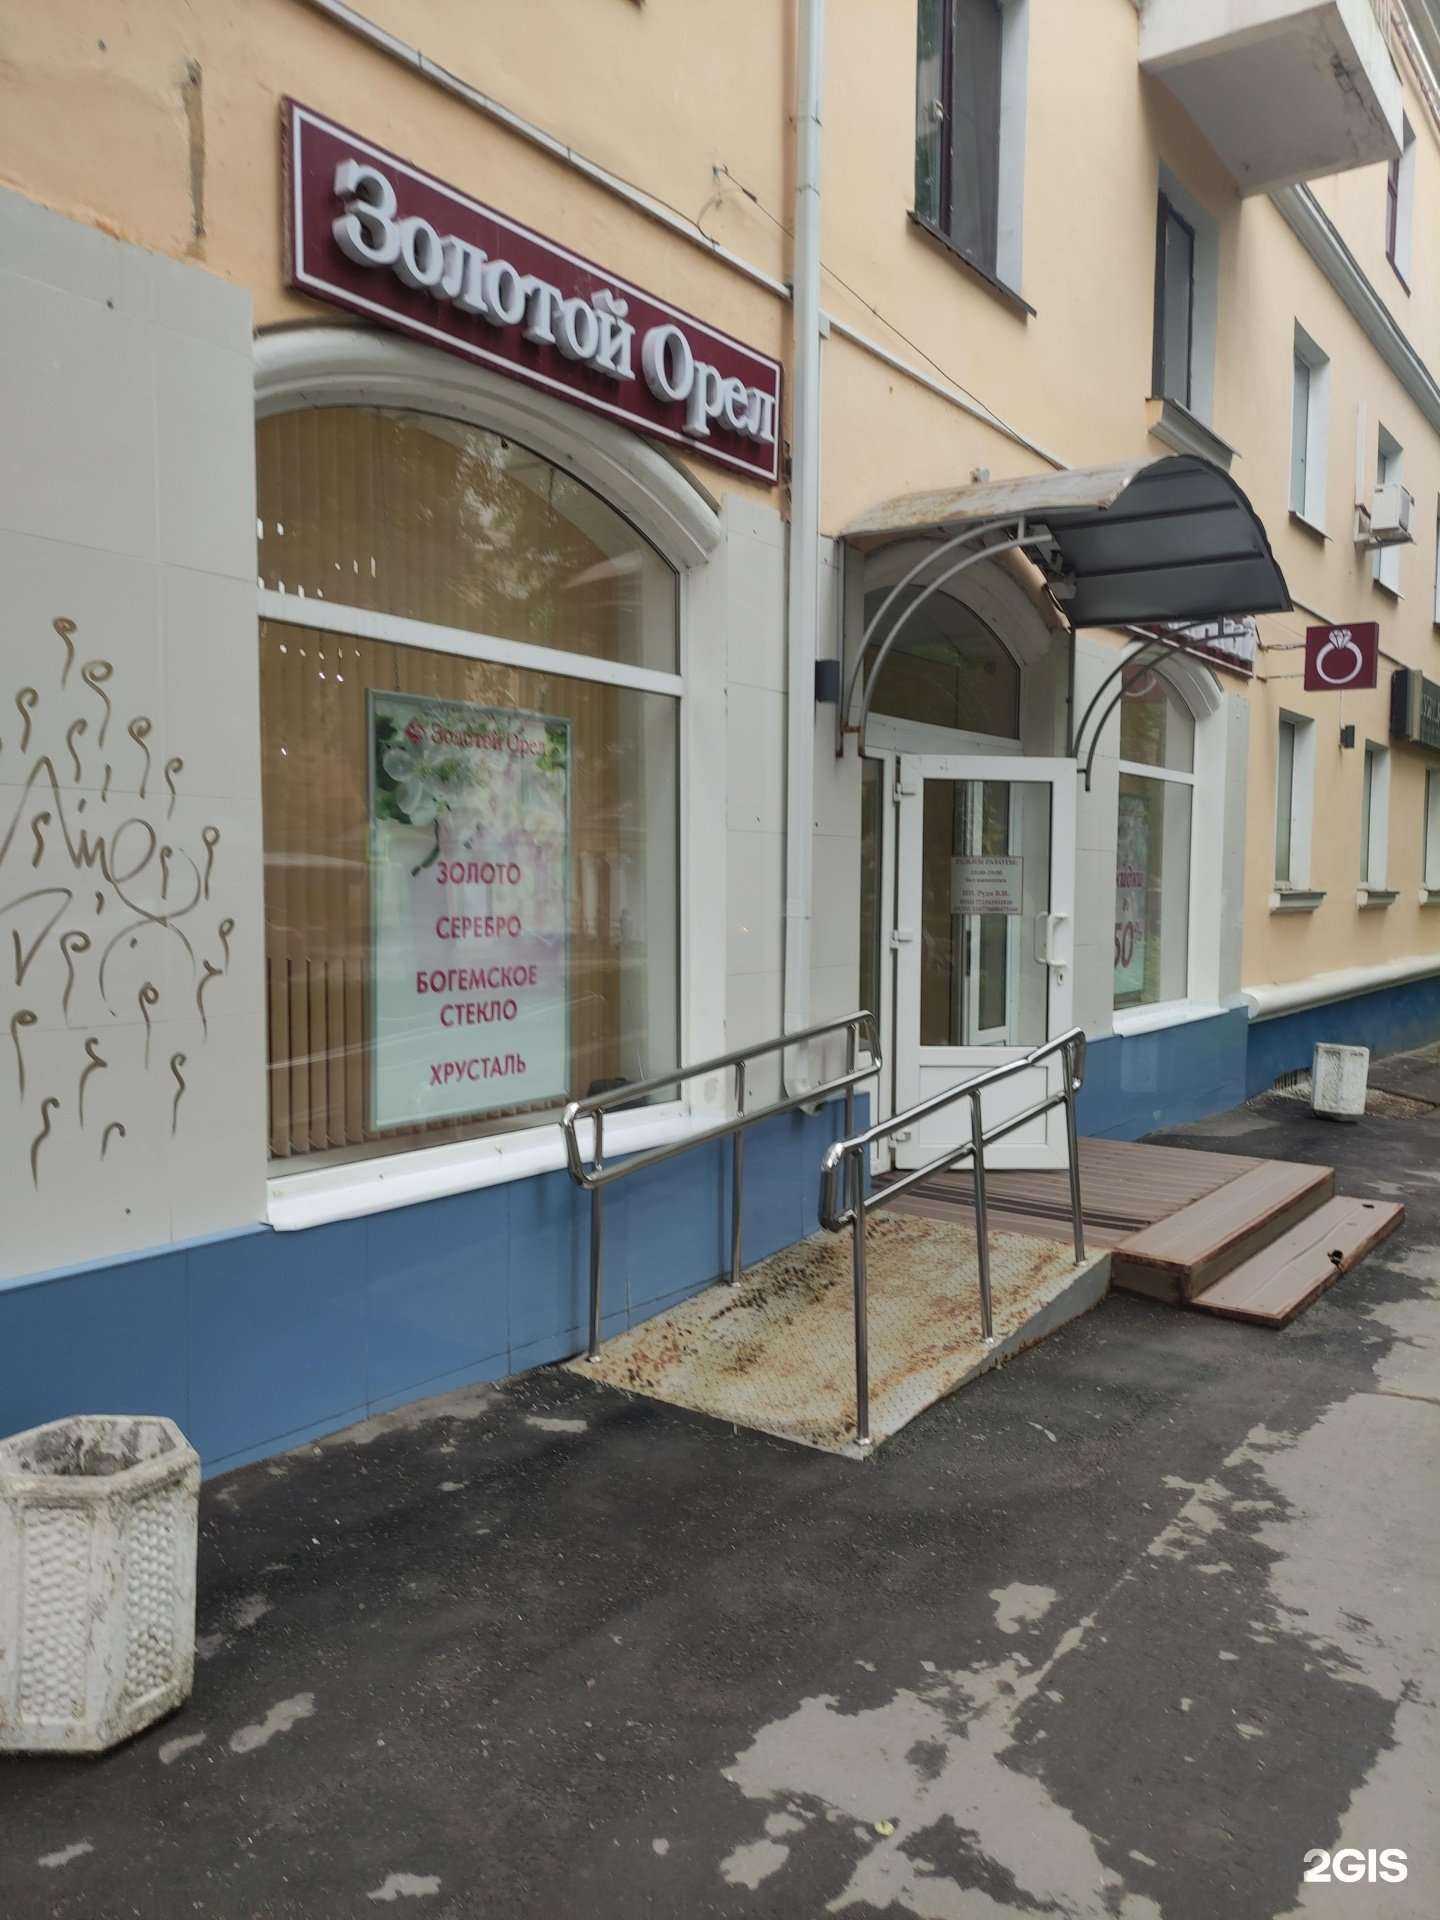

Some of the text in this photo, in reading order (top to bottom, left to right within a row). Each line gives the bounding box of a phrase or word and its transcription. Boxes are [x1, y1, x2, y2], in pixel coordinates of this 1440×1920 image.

[332, 158, 776, 442] Золотой Орел
[437, 861, 521, 885] ЗОЛОТО
[435, 916, 522, 940] СЕРЕБРО
[416, 965, 538, 994] БОГЕМСКОЕ
[440, 999, 518, 1028] СТЕКЛО
[430, 1053, 527, 1086] ХРУСТАЛЬ
